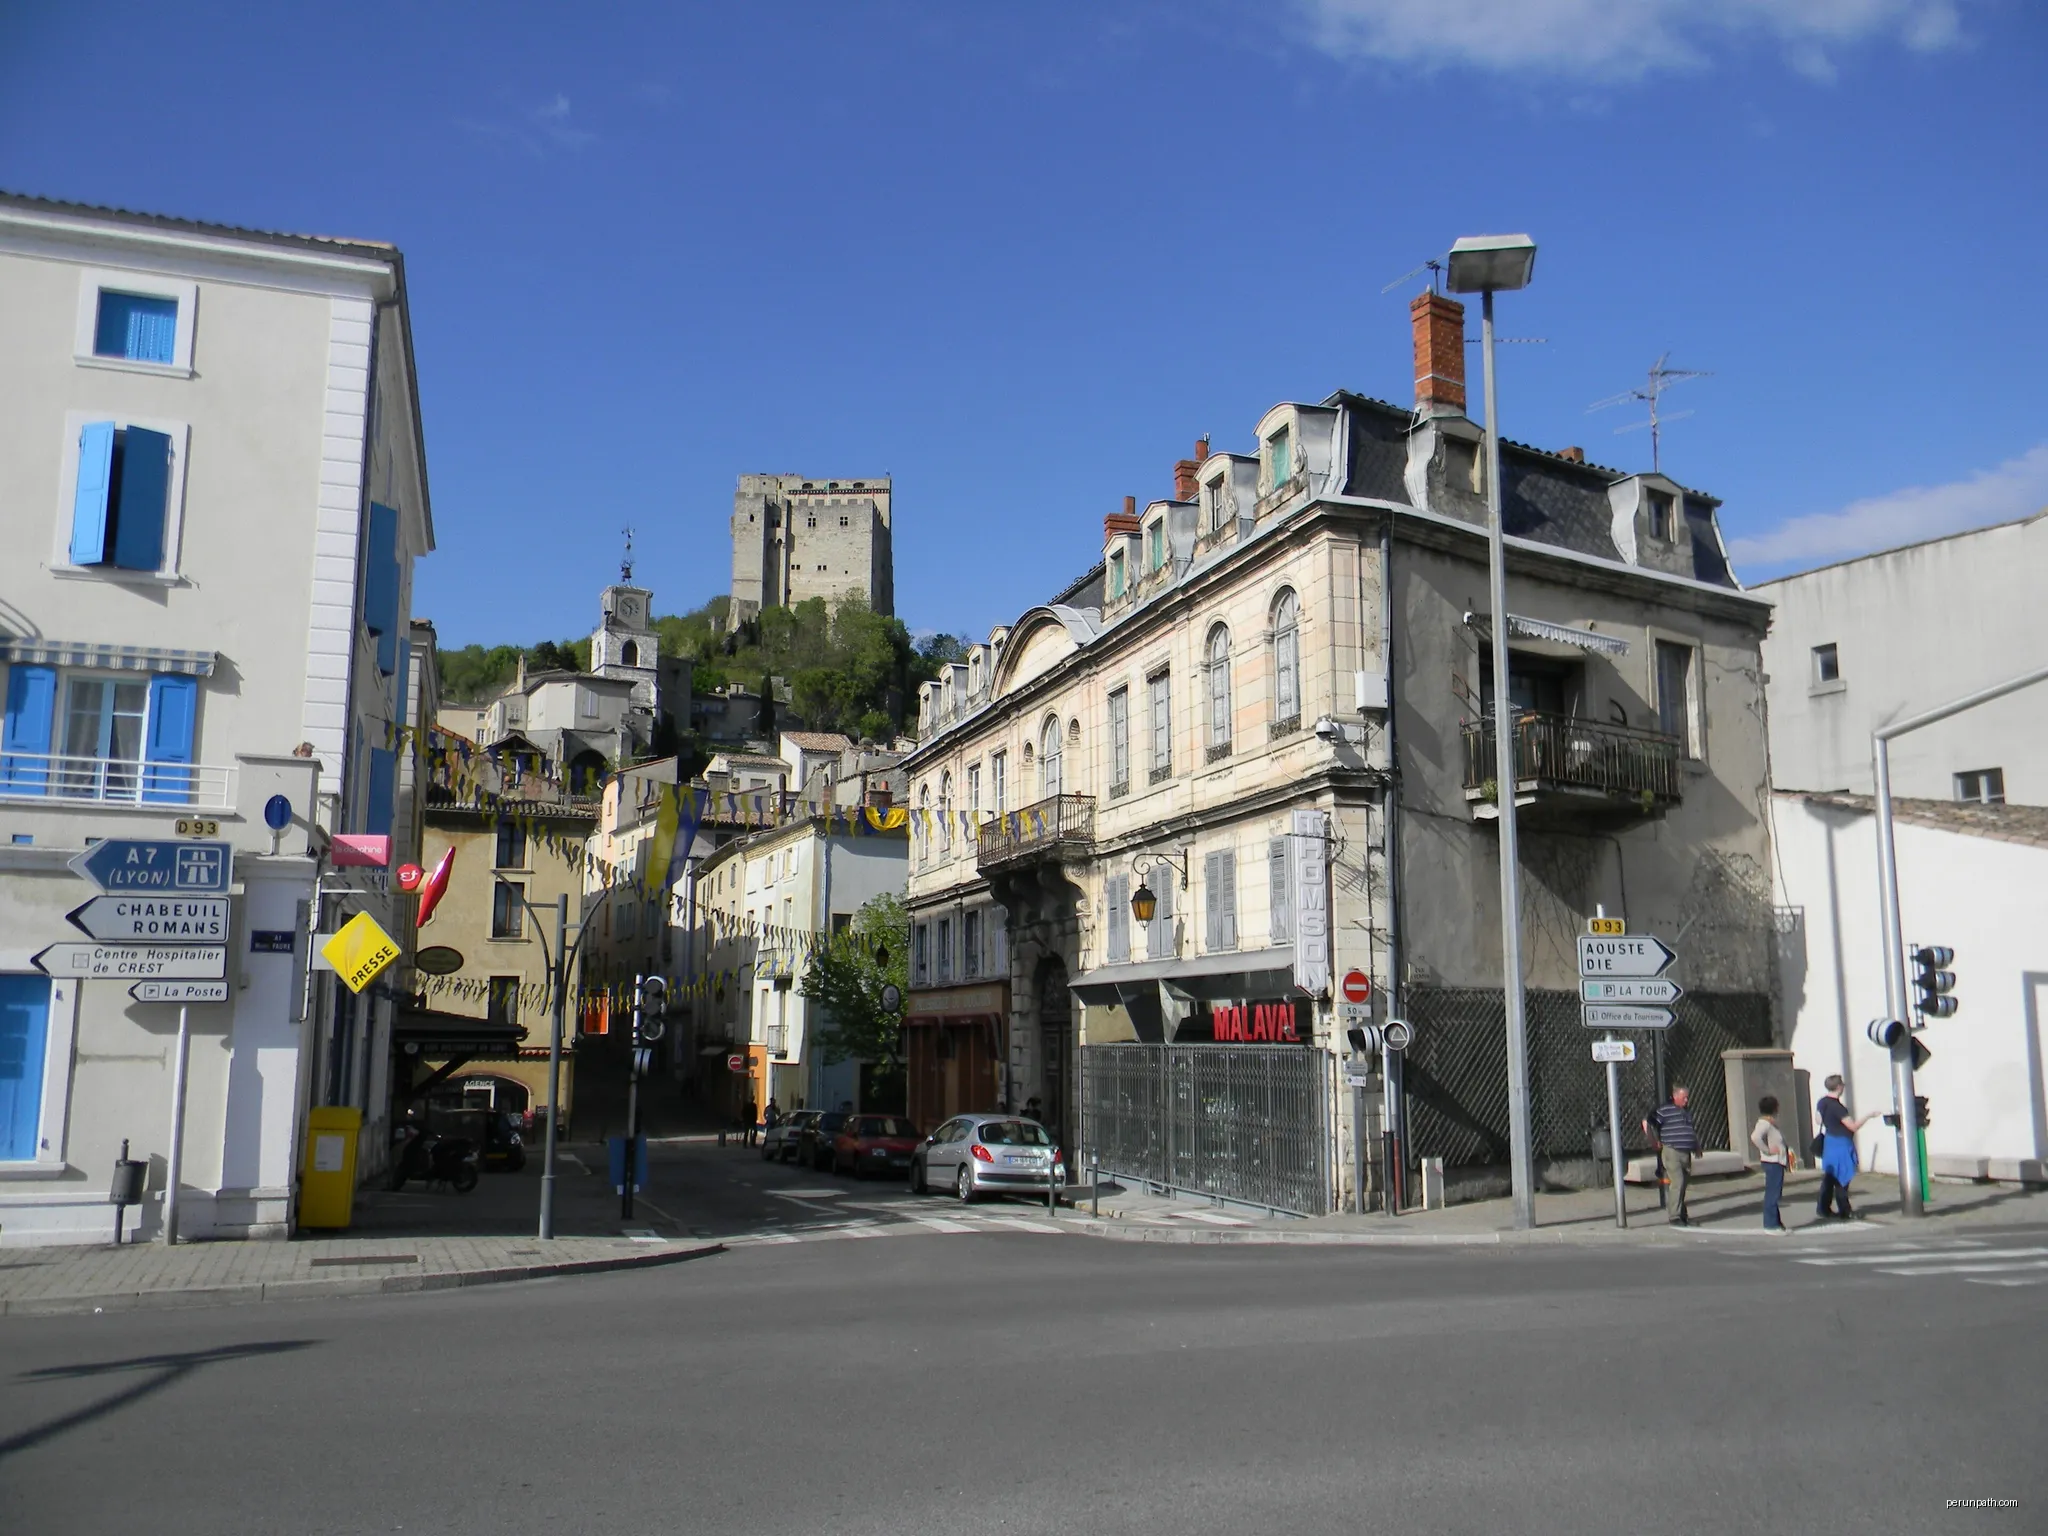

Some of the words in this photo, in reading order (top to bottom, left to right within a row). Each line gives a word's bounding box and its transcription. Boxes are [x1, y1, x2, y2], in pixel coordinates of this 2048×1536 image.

[178, 821, 188, 833] D
[194, 822, 216, 834] 93
[126, 848, 140, 864] A
[145, 848, 157, 864] 7
[108, 868, 170, 886] (LYON)
[1299, 811, 1328, 990] THOMSON
[117, 903, 220, 917] CHABEUIL
[133, 921, 219, 934] ROMANS
[1592, 921, 1600, 932] D
[1604, 921, 1622, 933] 93
[94, 948, 138, 960] Centre
[146, 949, 221, 962] Hospitalier
[1586, 943, 1645, 955] AOUSTE
[93, 963, 109, 973] de
[118, 963, 164, 974] CREST
[351, 946, 393, 986] PRESSE
[1586, 959, 1612, 970] DIE
[164, 986, 179, 996] La
[186, 986, 222, 997] Poste
[1619, 986, 1632, 996] LA
[1640, 986, 1668, 996] TOUR
[1347, 1007, 1357, 1015] 50
[1601, 1012, 1622, 1020] Office
[1623, 1012, 1632, 1020] du
[1634, 1012, 1664, 1021] Tourisme
[1214, 1003, 1301, 1041] MALAVAL
